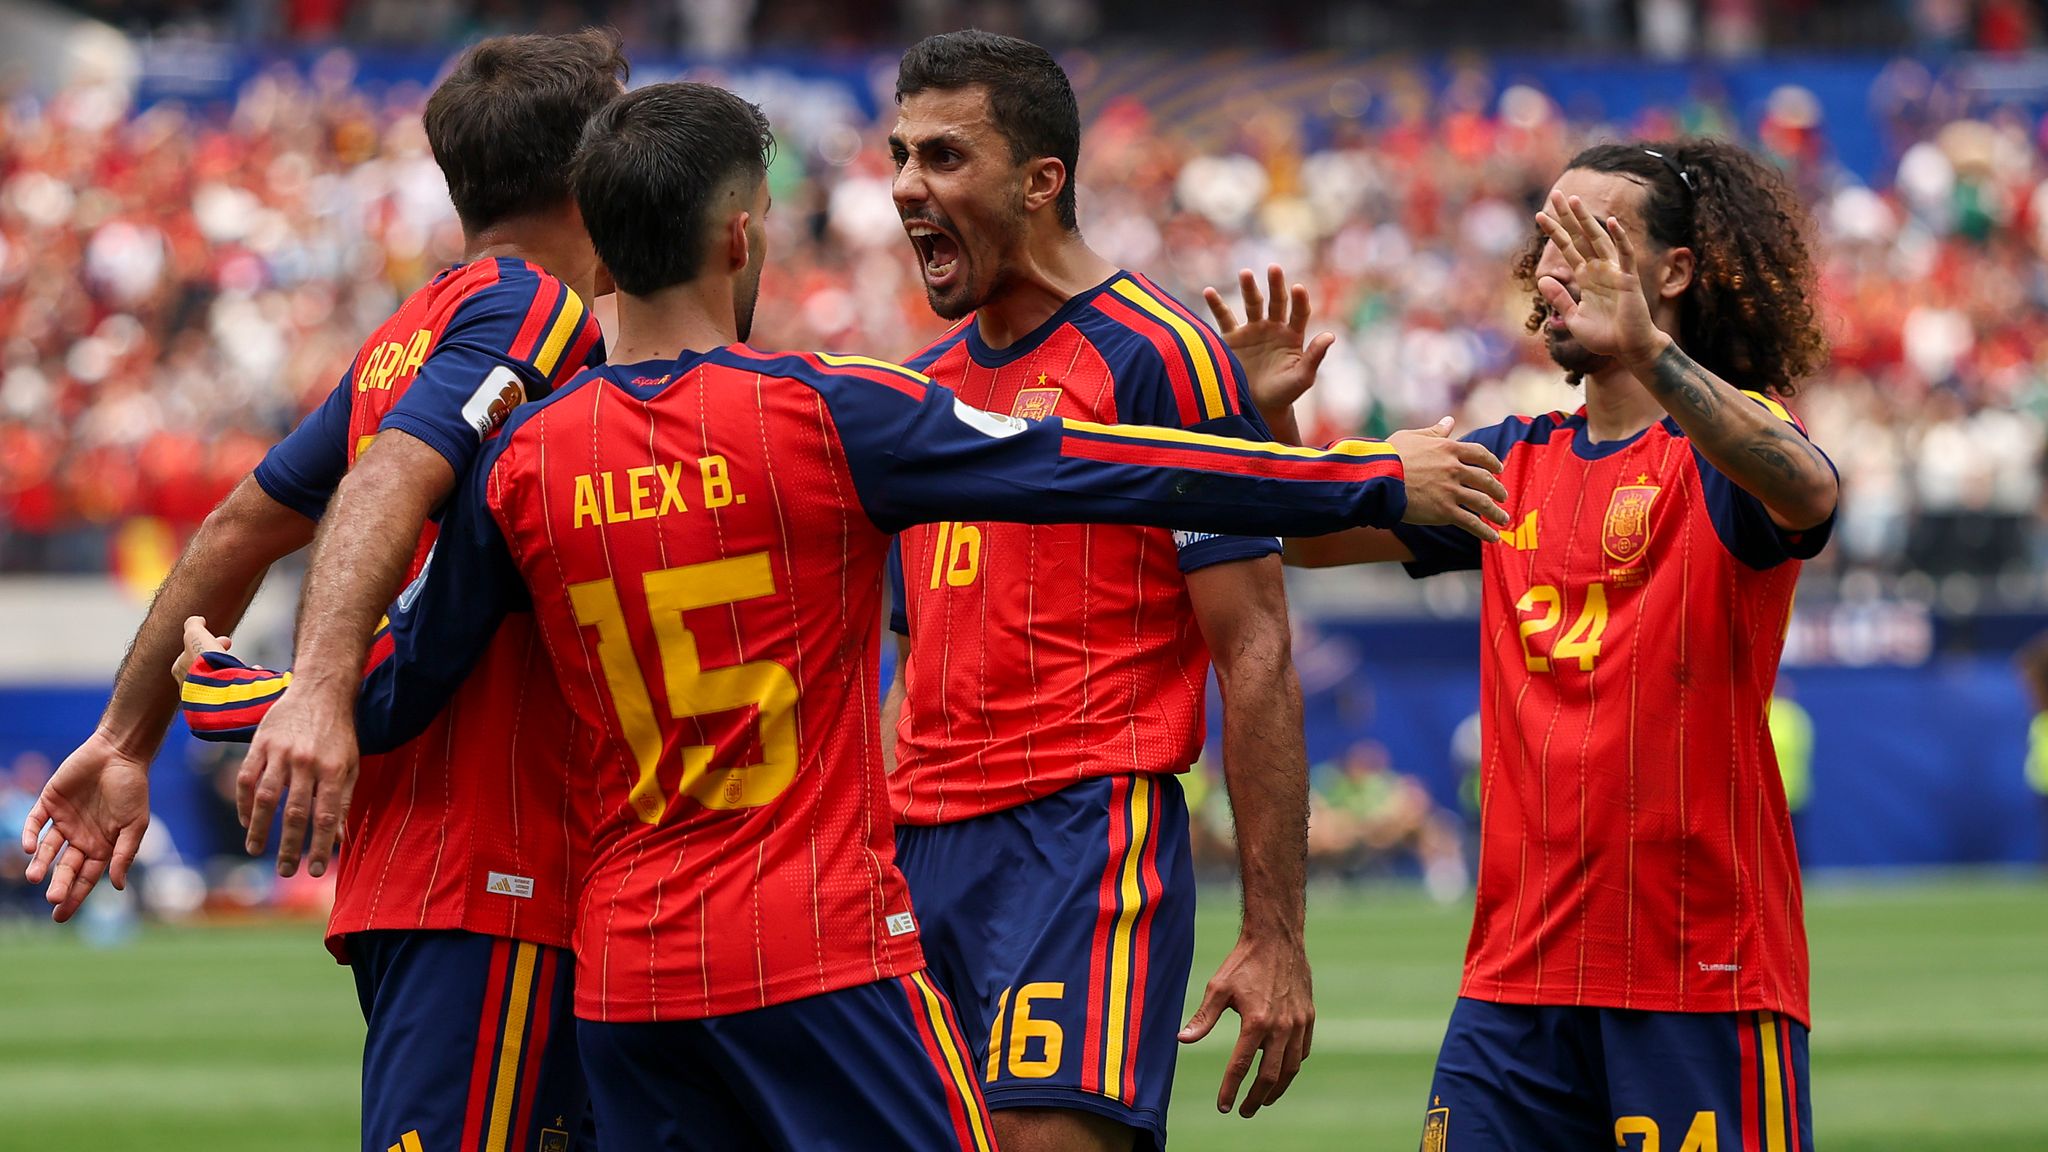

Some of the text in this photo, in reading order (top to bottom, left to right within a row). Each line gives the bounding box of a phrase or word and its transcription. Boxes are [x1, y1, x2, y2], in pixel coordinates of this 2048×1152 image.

[574, 455, 746, 529] ALEX B.
[930, 521, 981, 590] 16
[1515, 583, 1608, 672] 24
[567, 551, 799, 826] 15
[986, 982, 1064, 1083] 16
